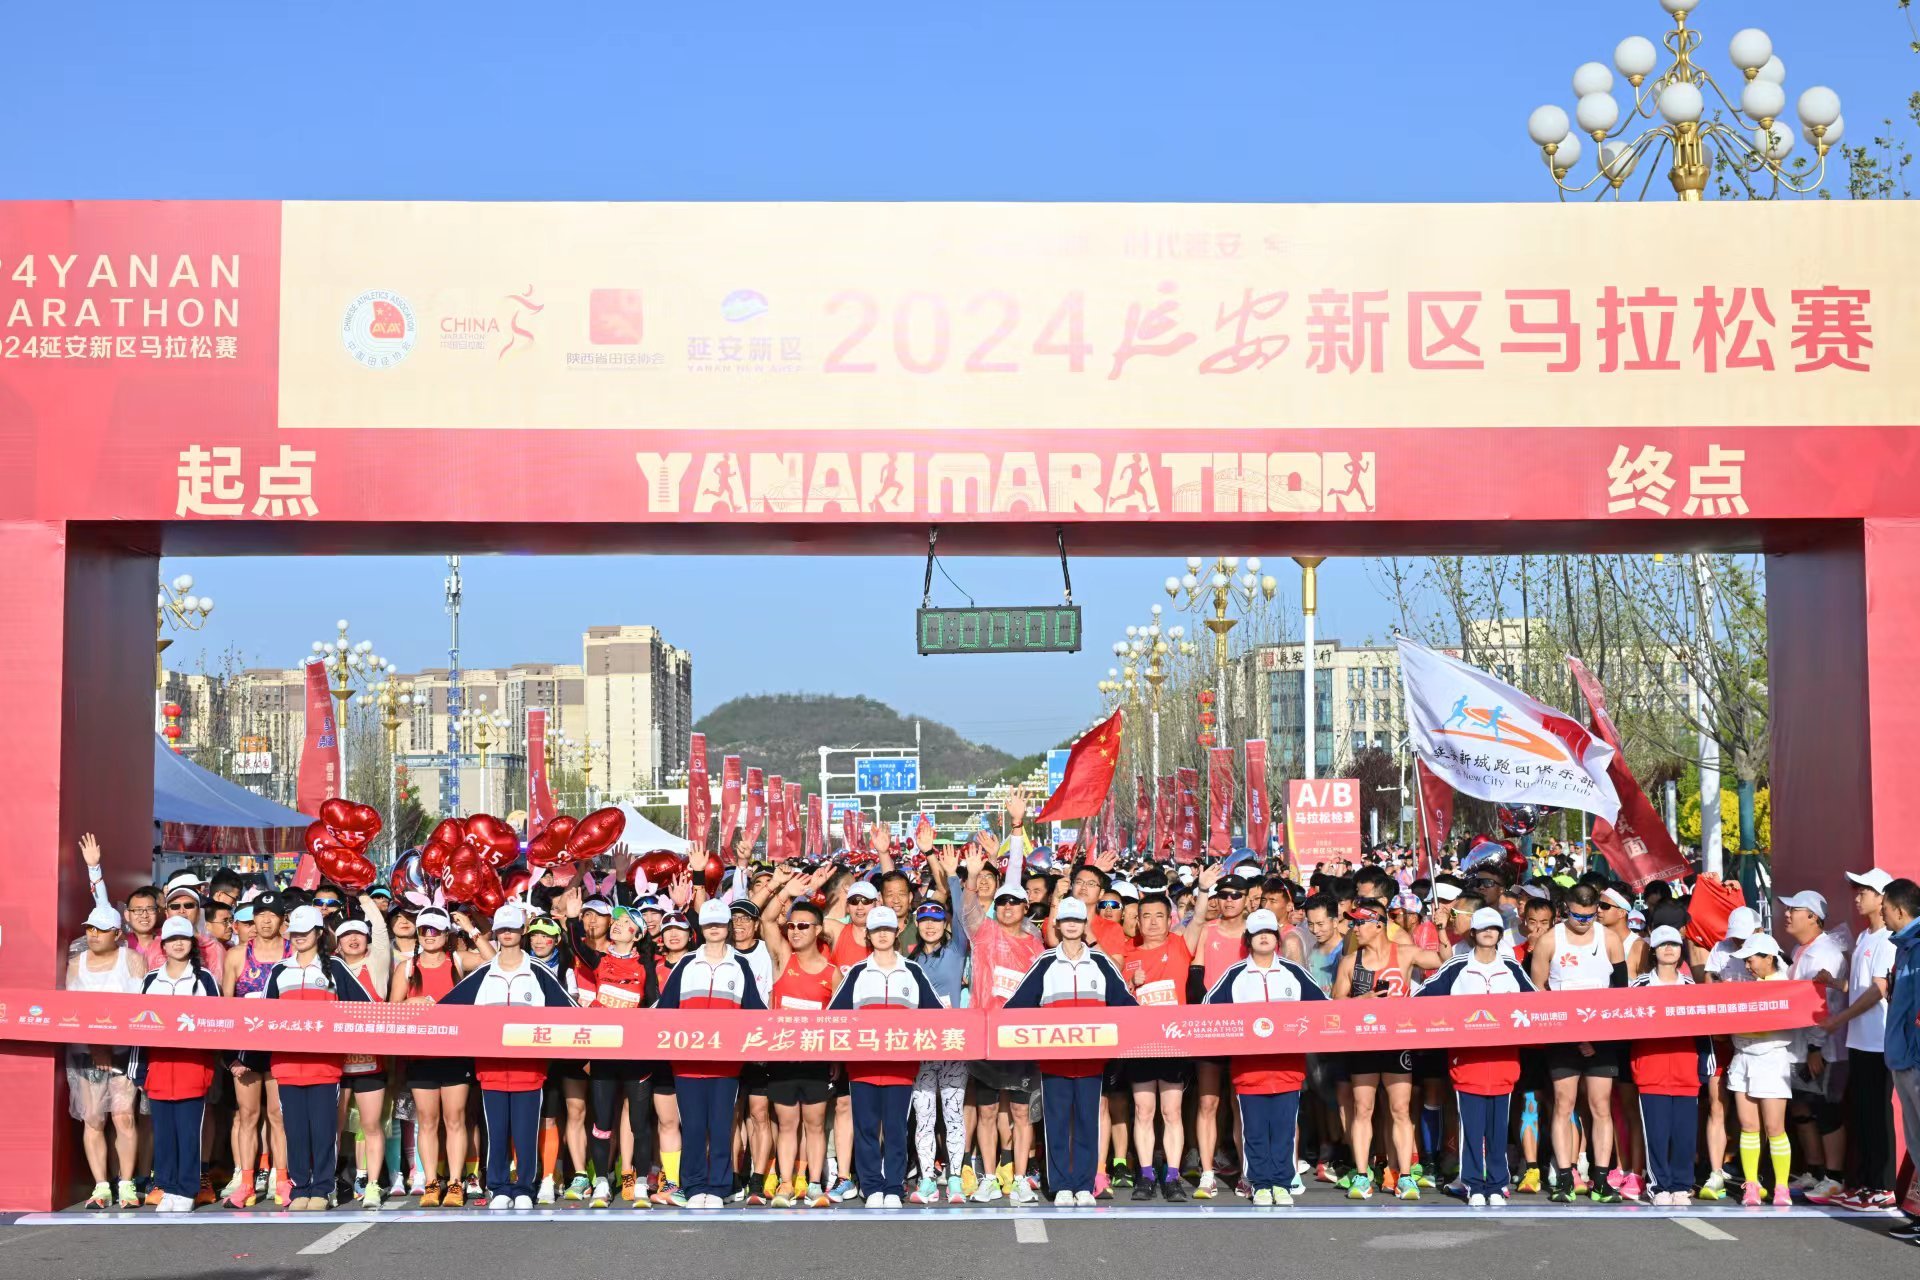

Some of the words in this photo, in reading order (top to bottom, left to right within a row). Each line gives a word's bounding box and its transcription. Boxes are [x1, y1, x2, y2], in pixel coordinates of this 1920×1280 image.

[0, 254, 239, 288] 4YANAN
[440, 317, 500, 333] CHINA
[0, 335, 238, 359] 24延安新区马拉松赛
[687, 336, 802, 361] 延安新区
[175, 443, 319, 519] 起点
[1606, 444, 1749, 517] 终点
[1296, 782, 1353, 808] A/B
[1463, 772, 1482, 786] New
[1482, 777, 1505, 788] City
[1564, 783, 1592, 797] Club
[466, 832, 504, 866] 6:15
[531, 1026, 592, 1045] 起点
[657, 1030, 722, 1050] 2024
[1014, 1026, 1102, 1045] START
